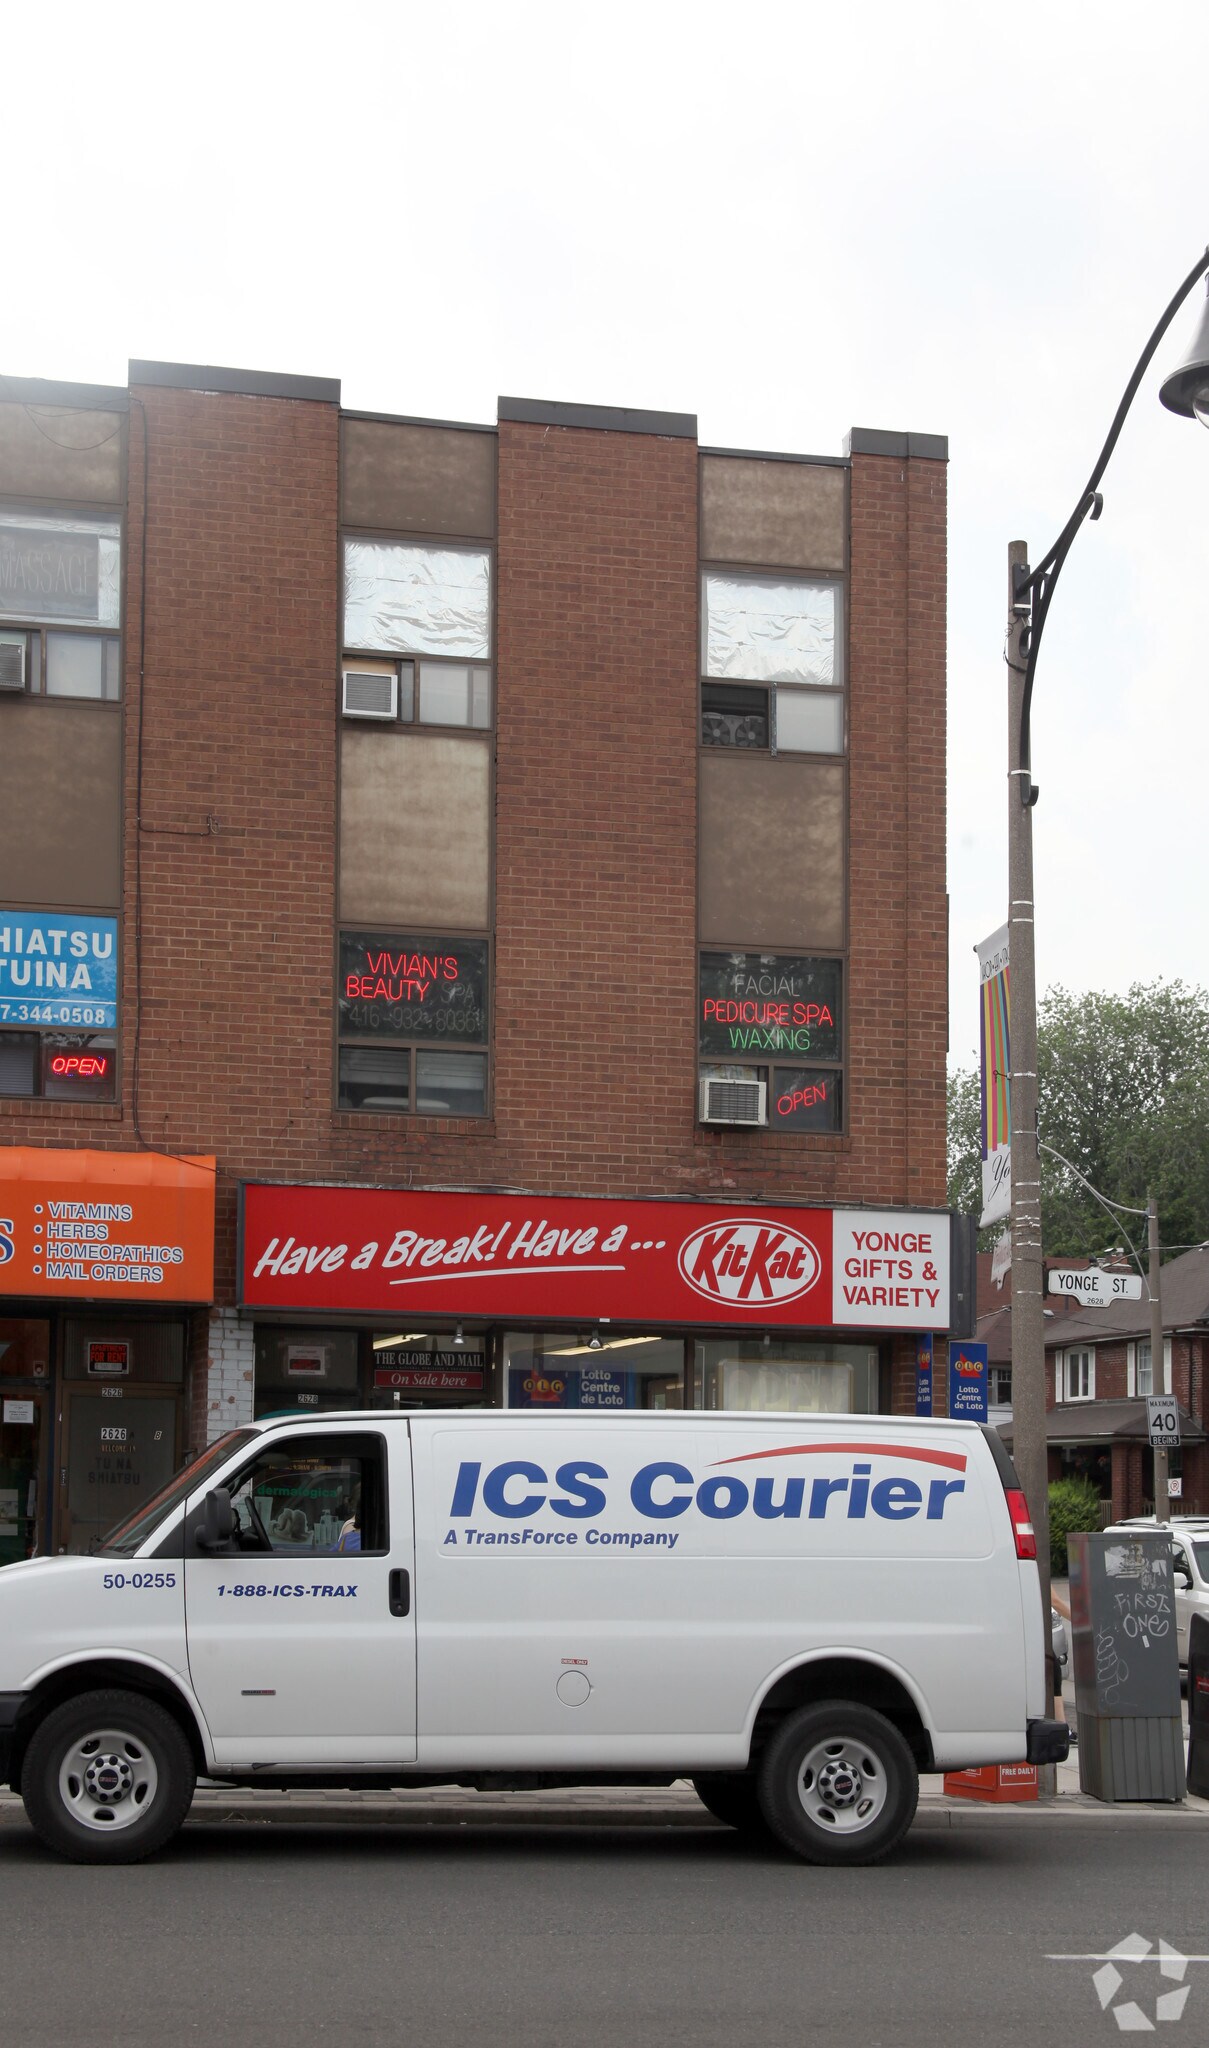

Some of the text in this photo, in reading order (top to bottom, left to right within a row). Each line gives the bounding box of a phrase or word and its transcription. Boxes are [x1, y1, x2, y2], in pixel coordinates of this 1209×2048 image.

[367, 952, 458, 979] VIVIAN'S
[346, 975, 475, 1004] BEAUTY SPA
[734, 973, 800, 997] FACIAL
[0, 1004, 105, 1025] 7-344-0508
[704, 998, 834, 1027] PEDICURE SPA
[728, 1028, 811, 1050] WAXING
[52, 1056, 107, 1075] OPEN
[776, 1081, 827, 1116] OPEN
[48, 1201, 133, 1222] VITAMINS
[47, 1221, 109, 1241] HERBS
[253, 1236, 346, 1278] Have
[350, 1241, 379, 1270] a
[381, 1221, 512, 1269] Break!
[506, 1219, 600, 1260] Have
[851, 1231, 932, 1253] YONGE
[47, 1241, 184, 1264] HOMEOPATHICS
[46, 1262, 164, 1283] MAIL ORDERS
[844, 1257, 938, 1281] GIFTS &
[1058, 1274, 1128, 1294] YONGE ST.
[842, 1285, 940, 1308] VARIETY
[1087, 1297, 1104, 1305] 2628
[90, 1352, 127, 1363] FOR RENT
[374, 1352, 484, 1367] THE GLOBE AND MAIL
[955, 1361, 983, 1372] OLG
[391, 1373, 467, 1387] On Sale here
[581, 1369, 612, 1381] Lotto
[102, 1388, 122, 1398] 2626
[523, 1379, 564, 1393] OLG
[581, 1381, 620, 1393] Centre
[958, 1385, 979, 1394] Lotto
[581, 1393, 623, 1405] de Loto
[954, 1401, 984, 1411] de Loto
[956, 1393, 981, 1402] Centre
[1152, 1413, 1176, 1432] 40
[102, 1428, 126, 1440] 2626
[1152, 1435, 1178, 1446] BEGINS
[257, 1485, 338, 1499] dermalogica
[449, 1460, 966, 1520] ICS Courier
[444, 1529, 679, 1549] A TransForce Company
[103, 1573, 176, 1589] 50-0255
[217, 1585, 358, 1597] 1-888-ICS-TRAX
[1001, 1766, 1035, 1776] FREE DAILY
